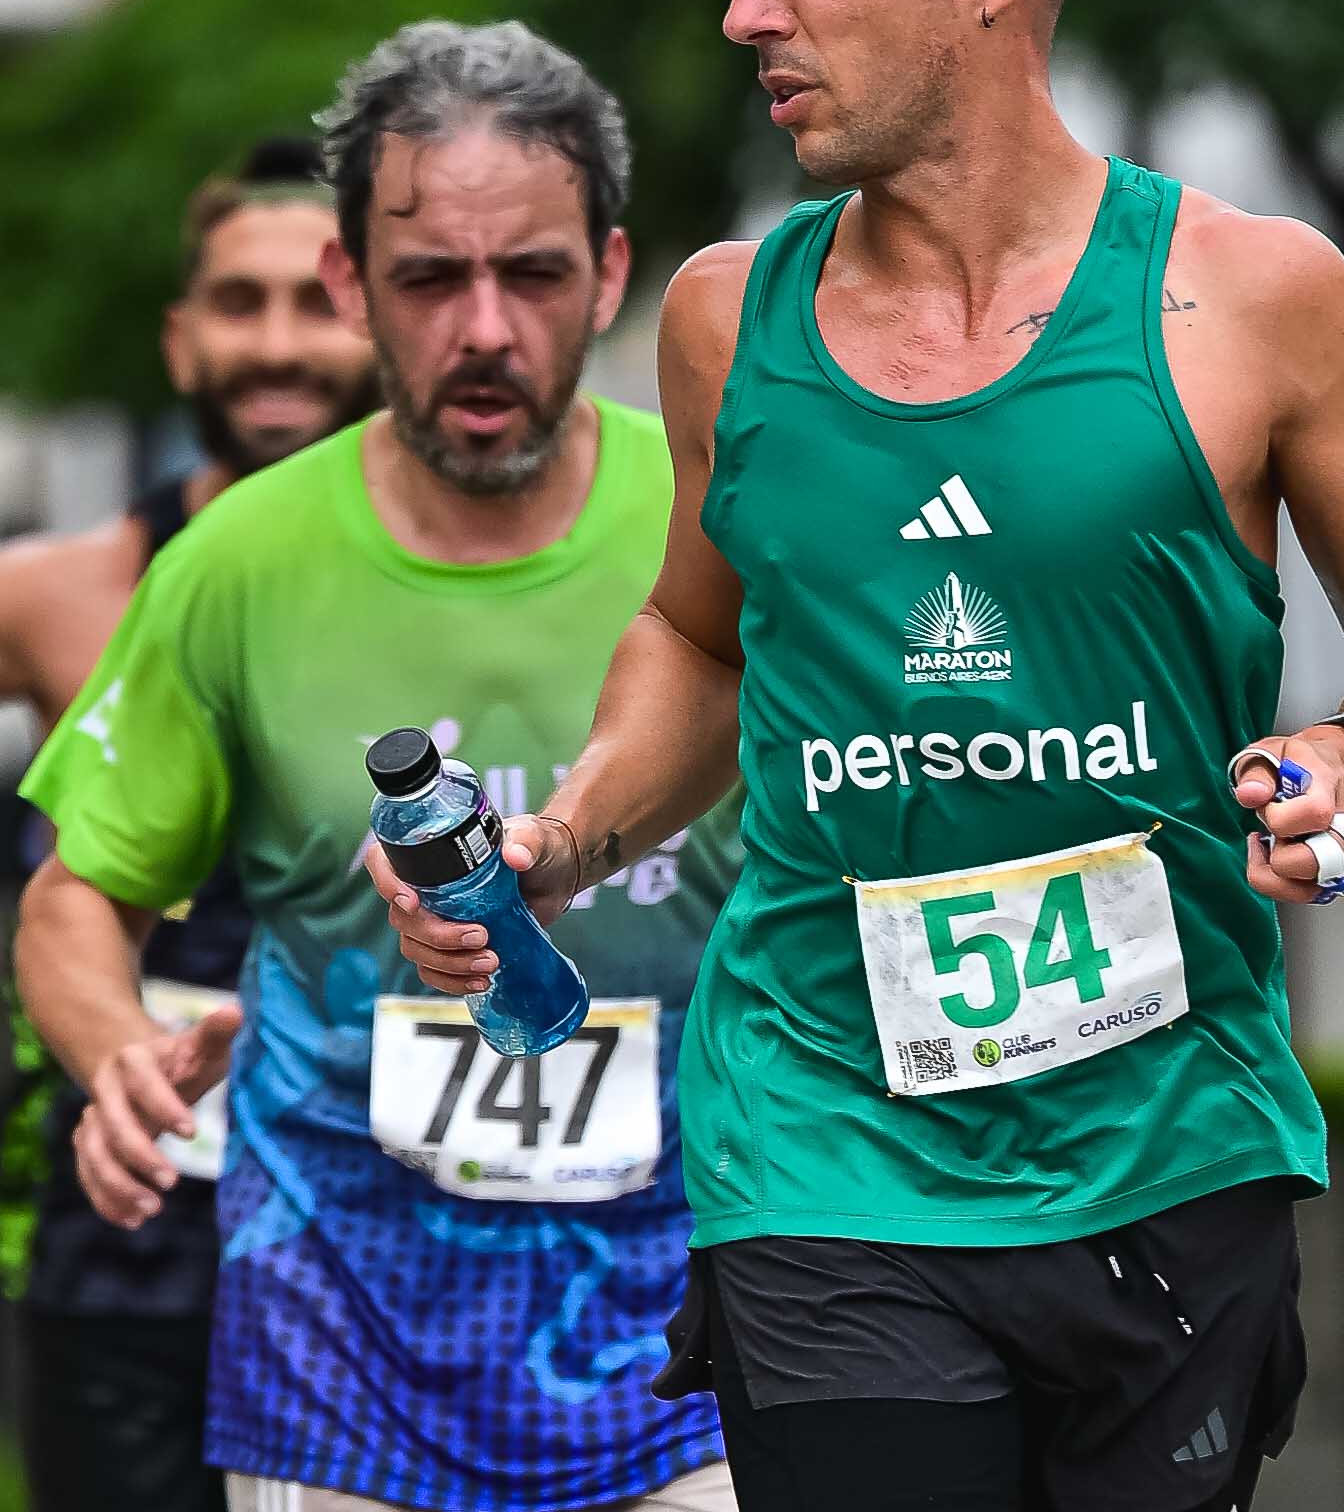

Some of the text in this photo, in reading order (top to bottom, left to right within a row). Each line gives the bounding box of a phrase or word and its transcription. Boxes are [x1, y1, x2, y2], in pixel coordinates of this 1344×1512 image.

[904, 649, 1012, 671] MARATON
[904, 671, 948, 683] BUENOS
[801, 701, 1158, 812] personal
[920, 872, 1112, 1029] 54
[1077, 1001, 1162, 1038] CARUSO
[415, 1022, 622, 1147] 747
